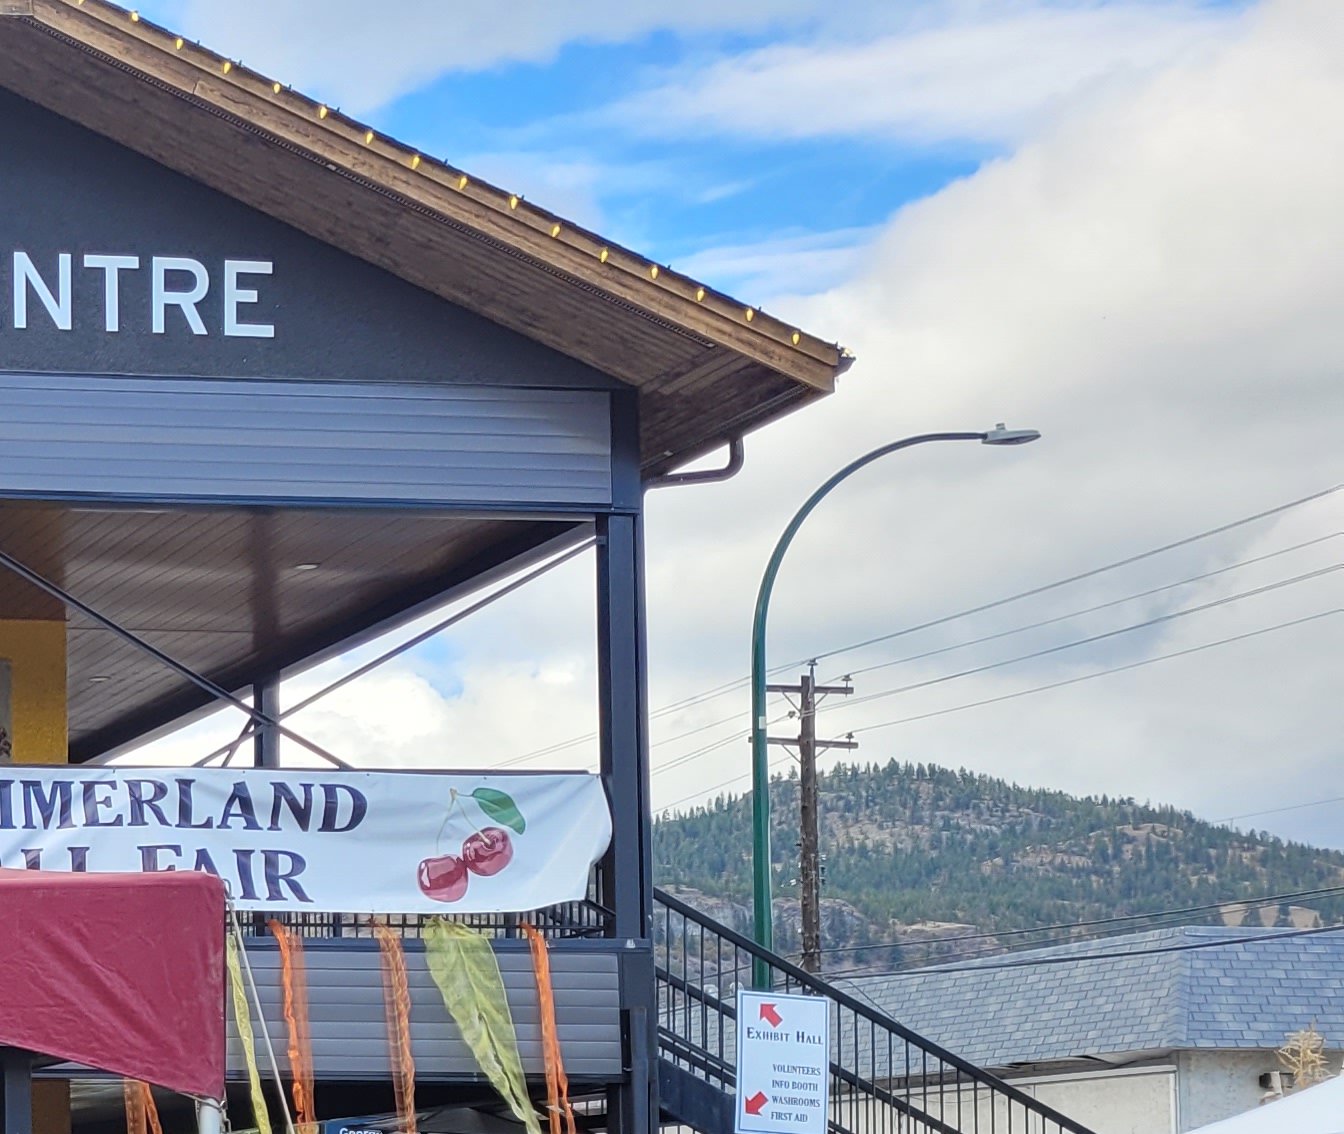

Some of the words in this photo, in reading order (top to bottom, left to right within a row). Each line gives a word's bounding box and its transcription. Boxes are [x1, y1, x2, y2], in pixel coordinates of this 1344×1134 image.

[746, 1026, 790, 1043] EXHIBIT
[796, 1030, 824, 1046] HALL
[772, 1063, 821, 1076] VOLUNTEERS
[771, 1079, 790, 1089] INFO
[792, 1080, 818, 1092] BOOTH
[771, 1095, 821, 1108] WASHROOMS
[770, 1111, 793, 1121] FIRST
[794, 1112, 808, 1122] AID
